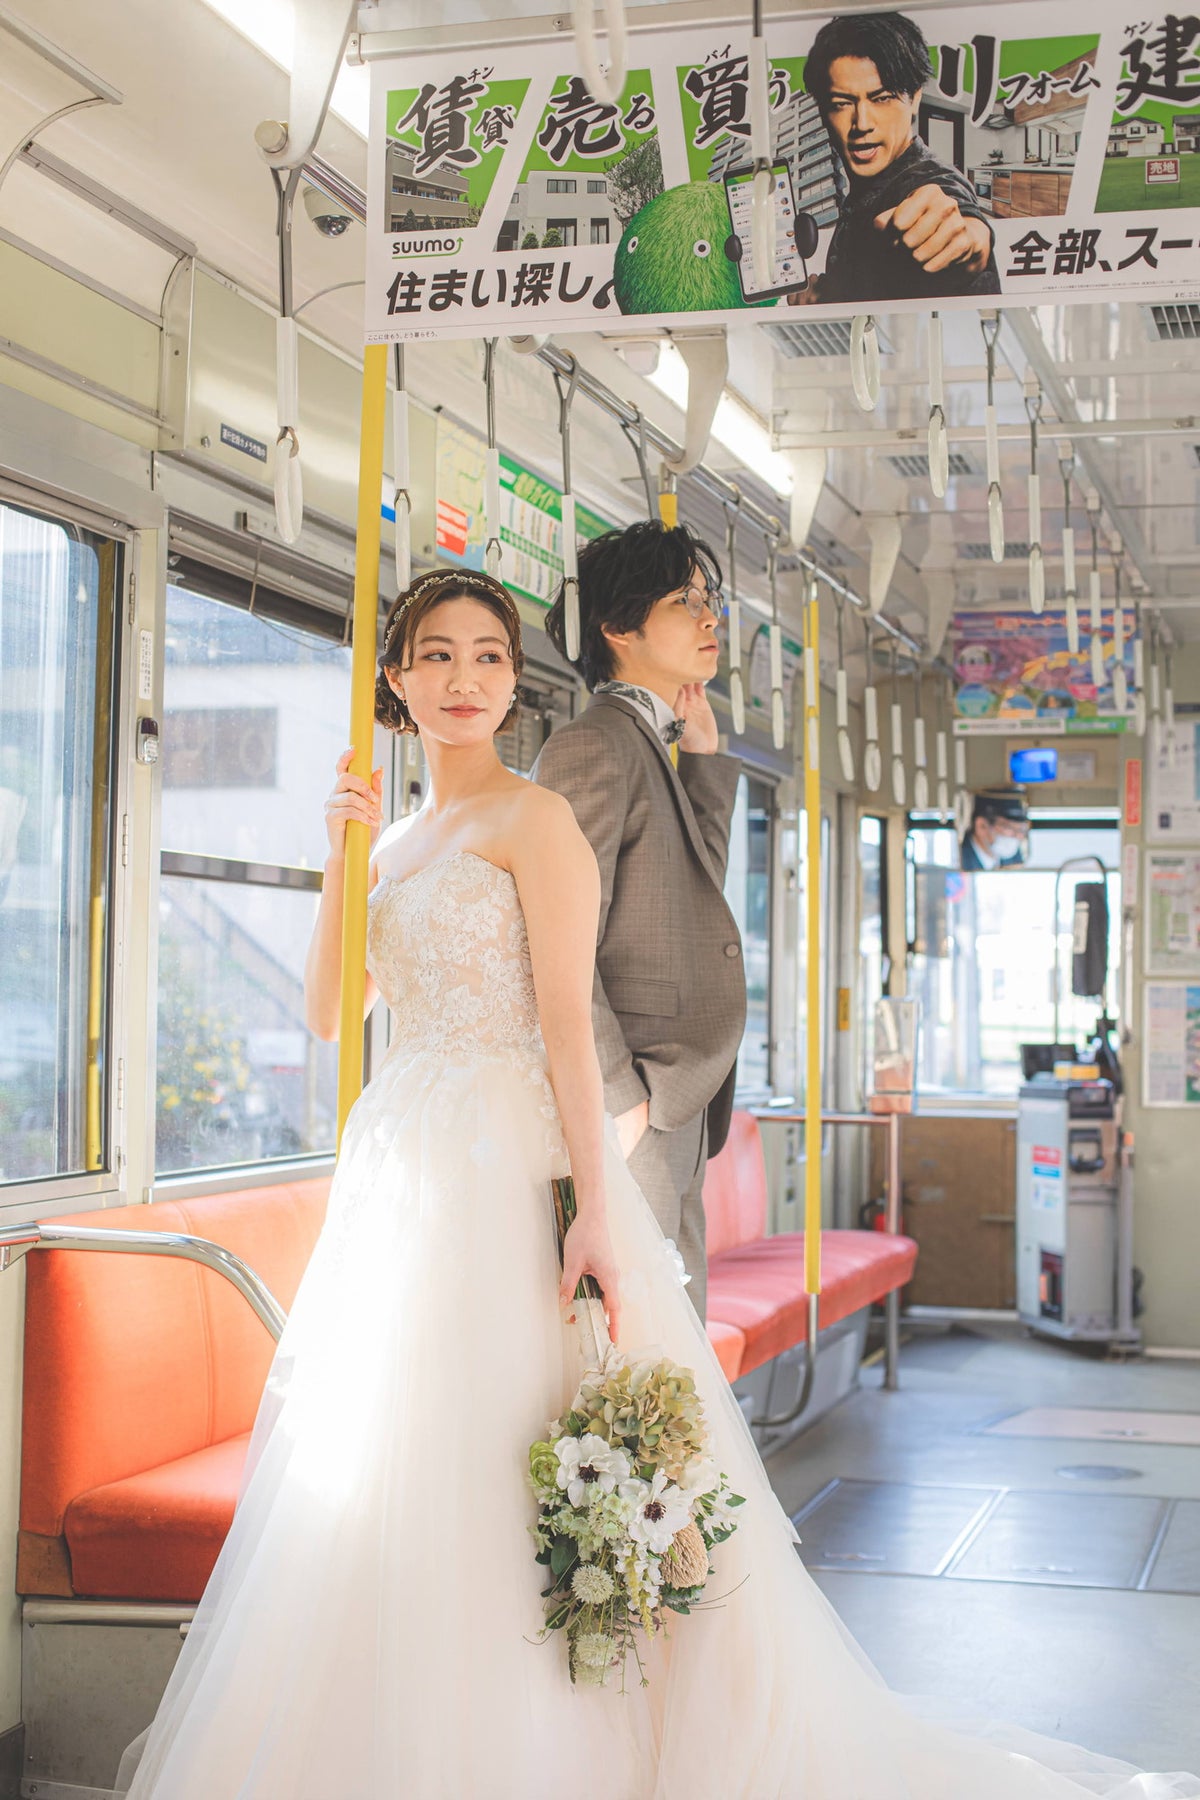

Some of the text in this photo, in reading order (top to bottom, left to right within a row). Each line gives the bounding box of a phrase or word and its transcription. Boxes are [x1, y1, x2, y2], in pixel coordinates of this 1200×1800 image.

[705, 44, 731, 63] バイ
[1124, 21, 1152, 37] ケン
[468, 66, 495, 83] チン
[939, 34, 1102, 123] リフォーム
[401, 76, 514, 174] 賃貸
[540, 77, 655, 162] 売る
[1150, 161, 1176, 175] 売地
[1006, 227, 1200, 277] 全部、スー
[386, 261, 594, 316] 住まい探し
